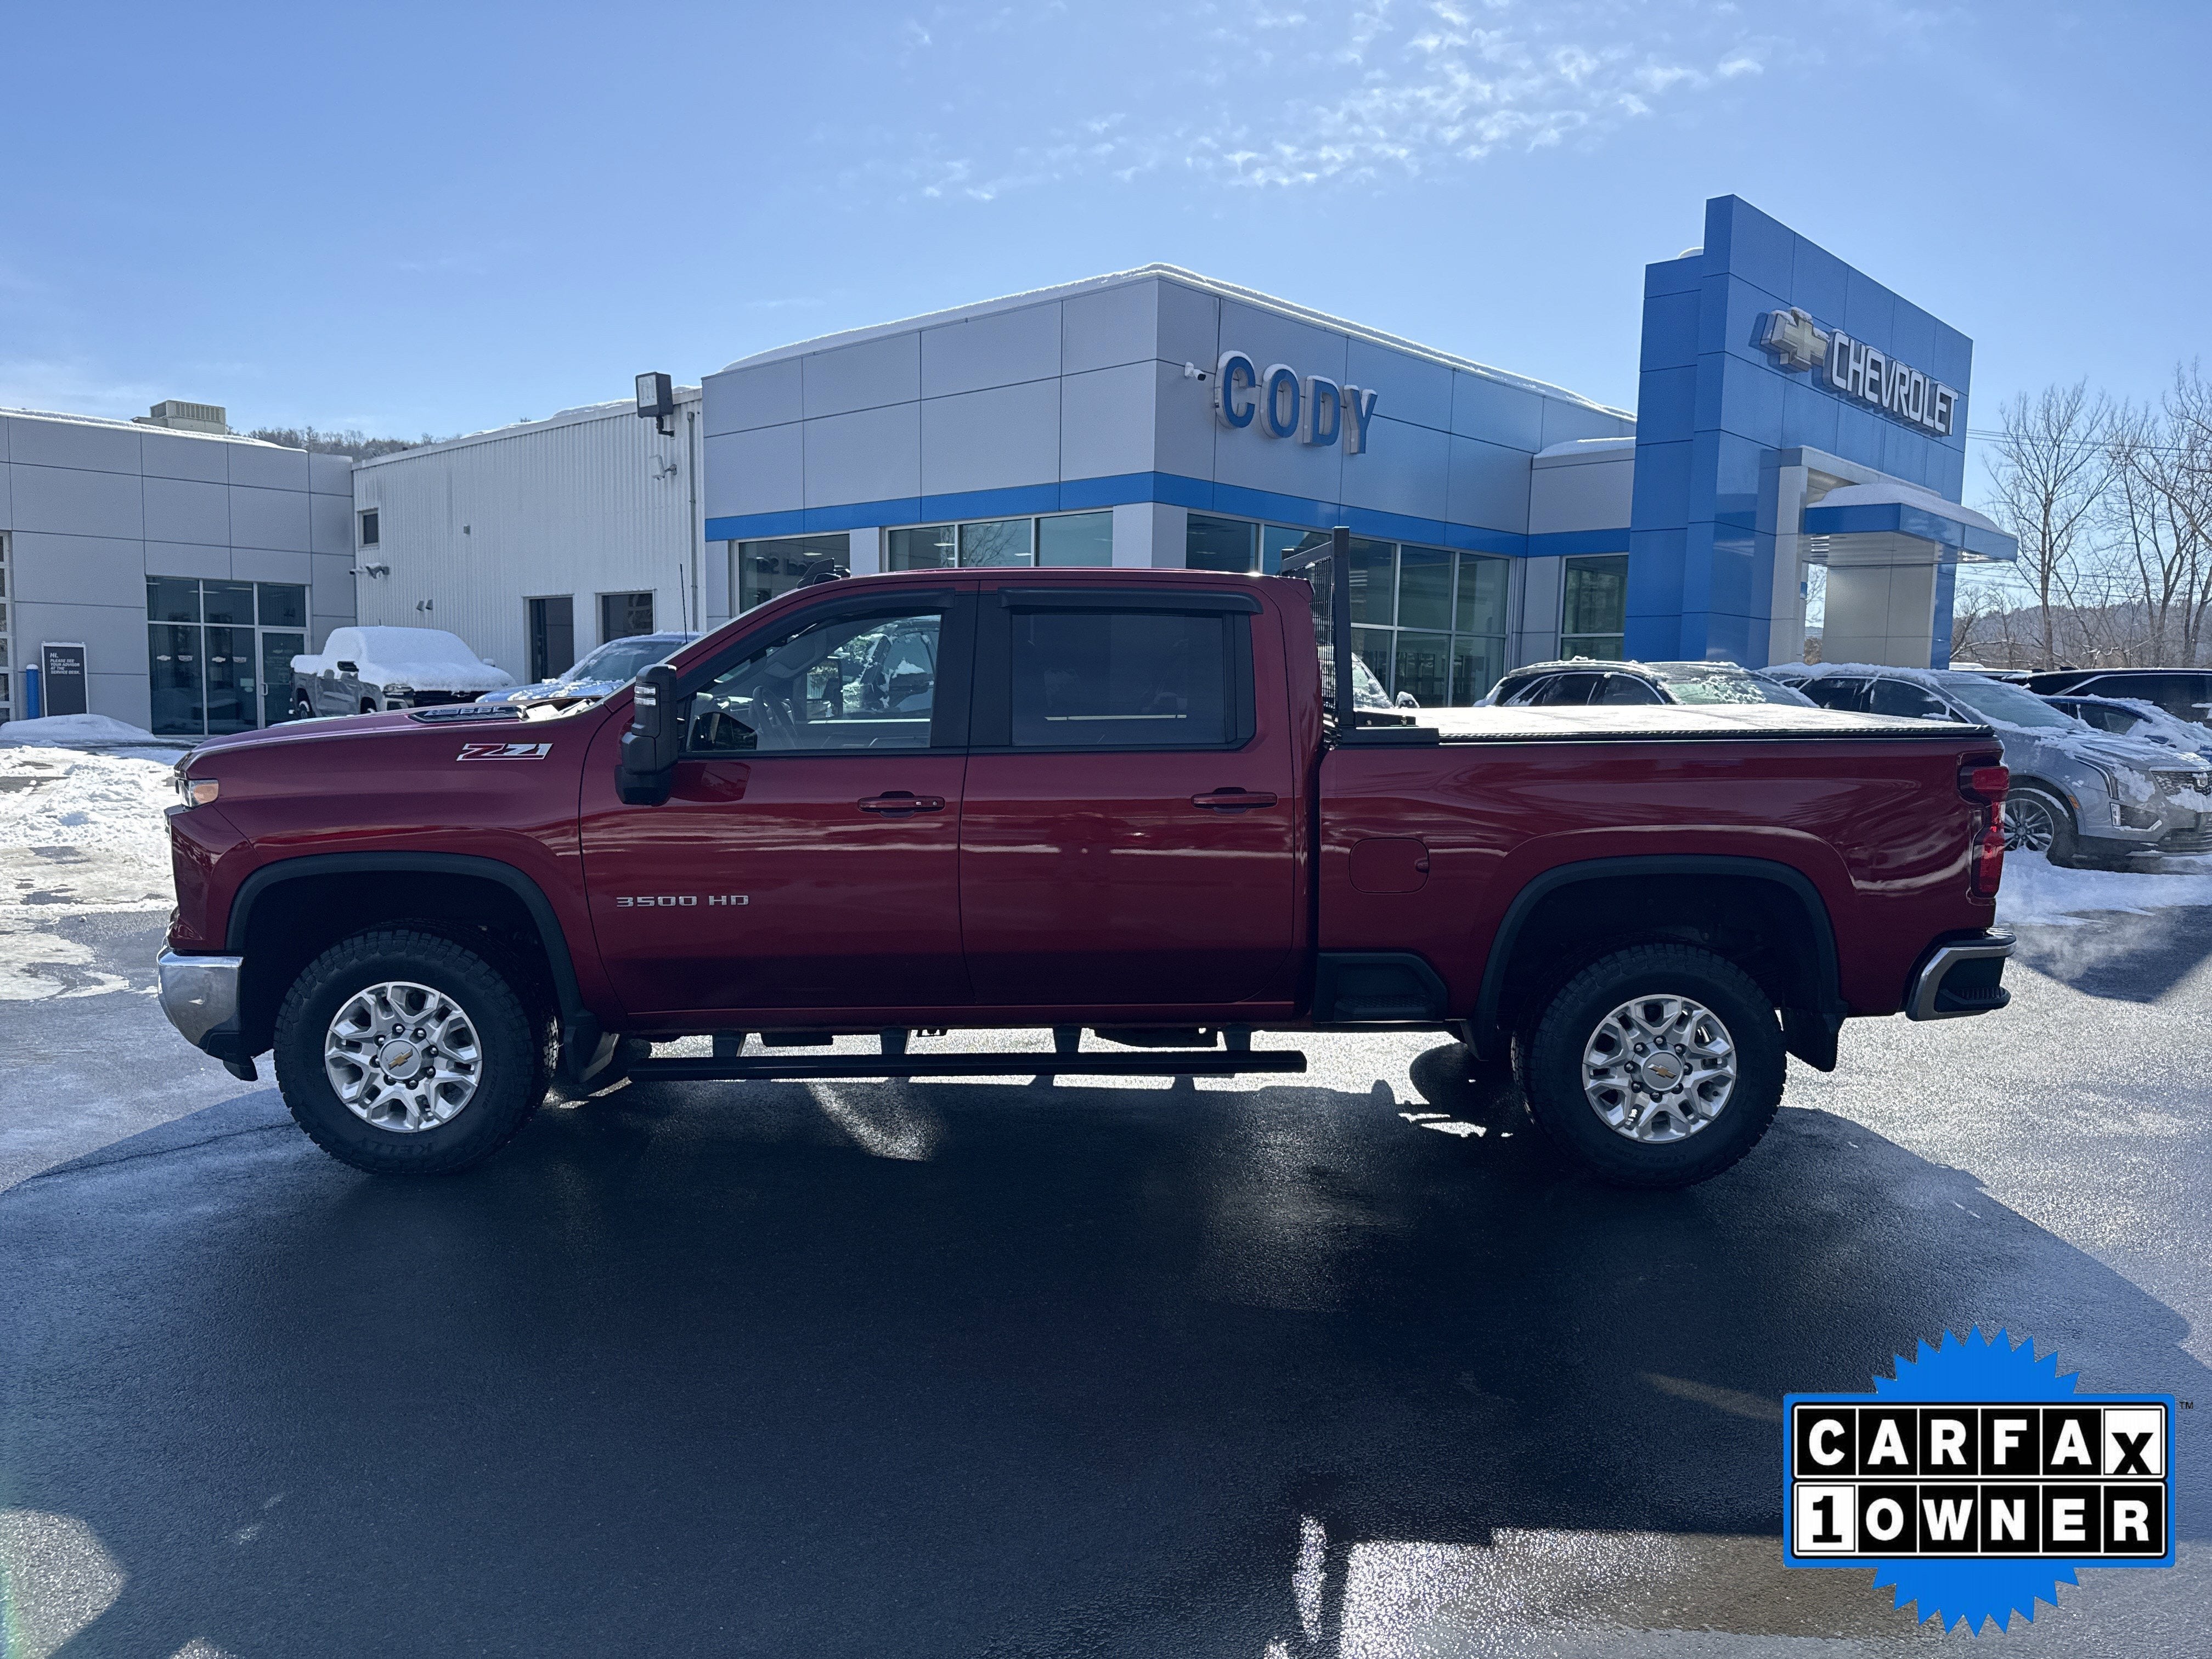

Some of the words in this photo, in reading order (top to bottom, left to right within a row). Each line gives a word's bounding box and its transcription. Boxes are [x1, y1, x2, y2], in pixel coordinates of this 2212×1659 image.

[1826, 329, 1959, 437] CHEVROLET
[1216, 351, 1378, 454] CODY
[460, 706, 506, 714] 6.6L
[456, 743, 553, 761] Z71
[616, 895, 697, 907] 3500
[708, 895, 749, 906] HD
[357, 1137, 434, 1156] KELLY
